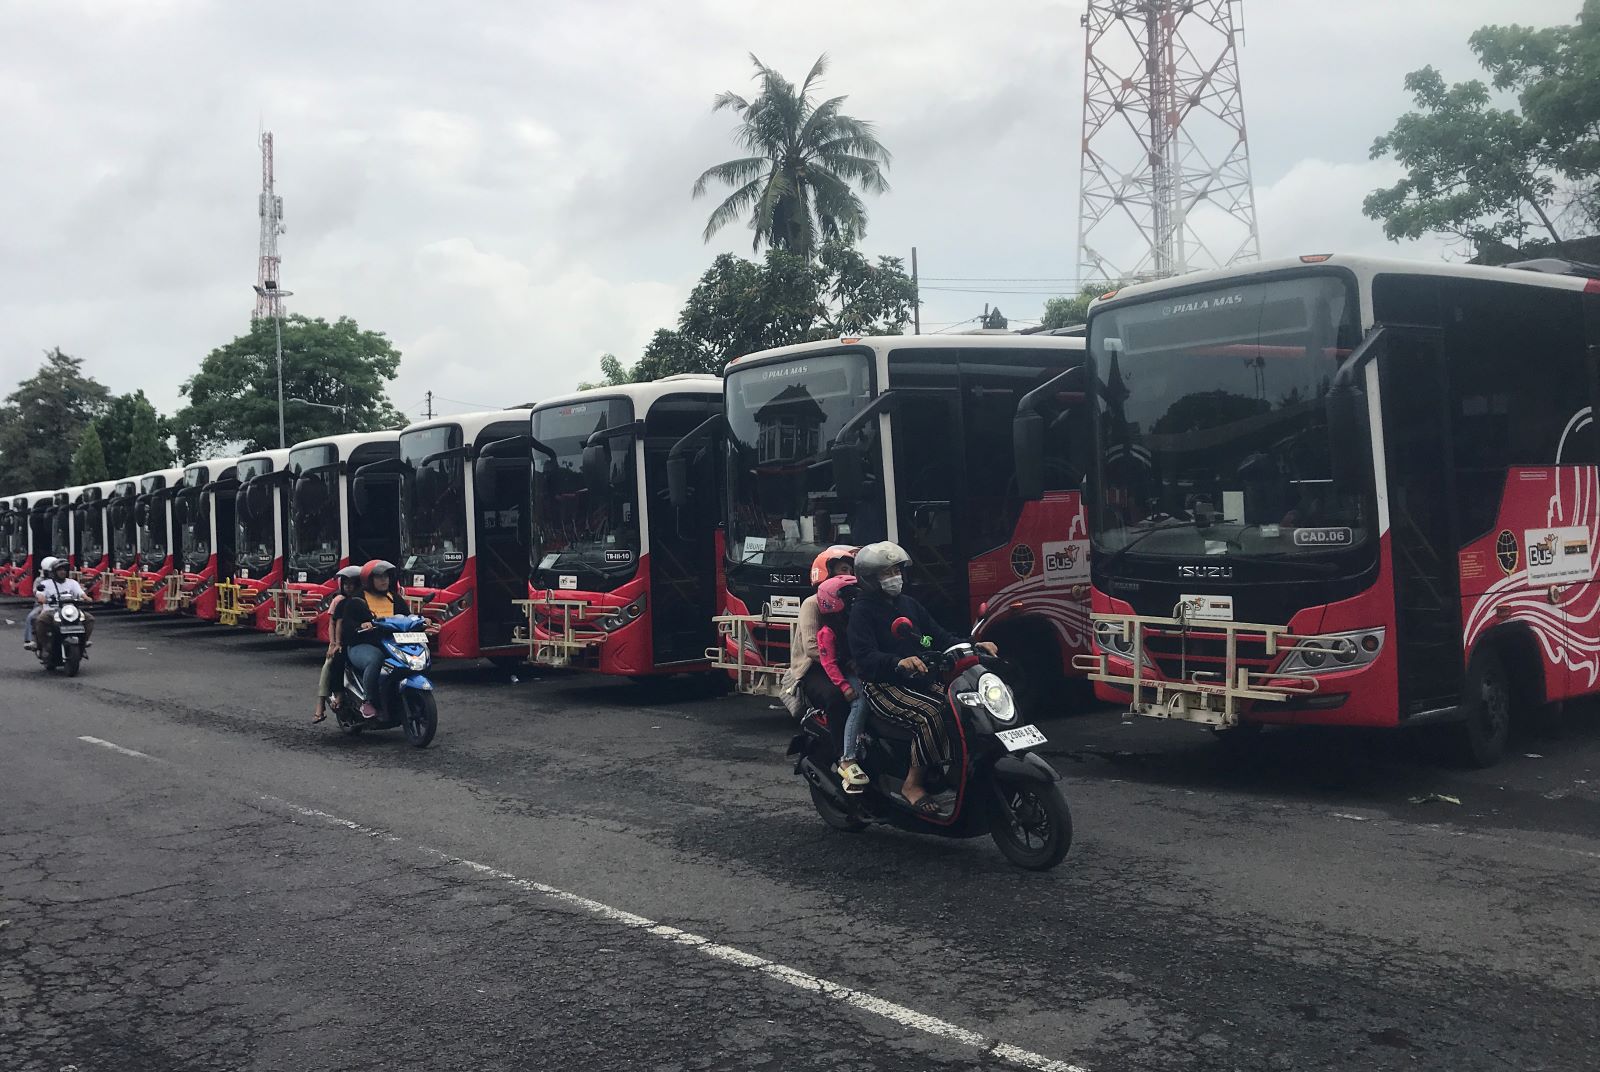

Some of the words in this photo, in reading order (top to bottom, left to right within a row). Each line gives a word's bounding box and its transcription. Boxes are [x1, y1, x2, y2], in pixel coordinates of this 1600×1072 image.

[1172, 300, 1209, 314] PIALA
[1213, 294, 1243, 307] MAS
[1300, 531, 1345, 542] CAD.06
[1178, 565, 1233, 578] ISUZU
[769, 573, 801, 583] ISUZU
